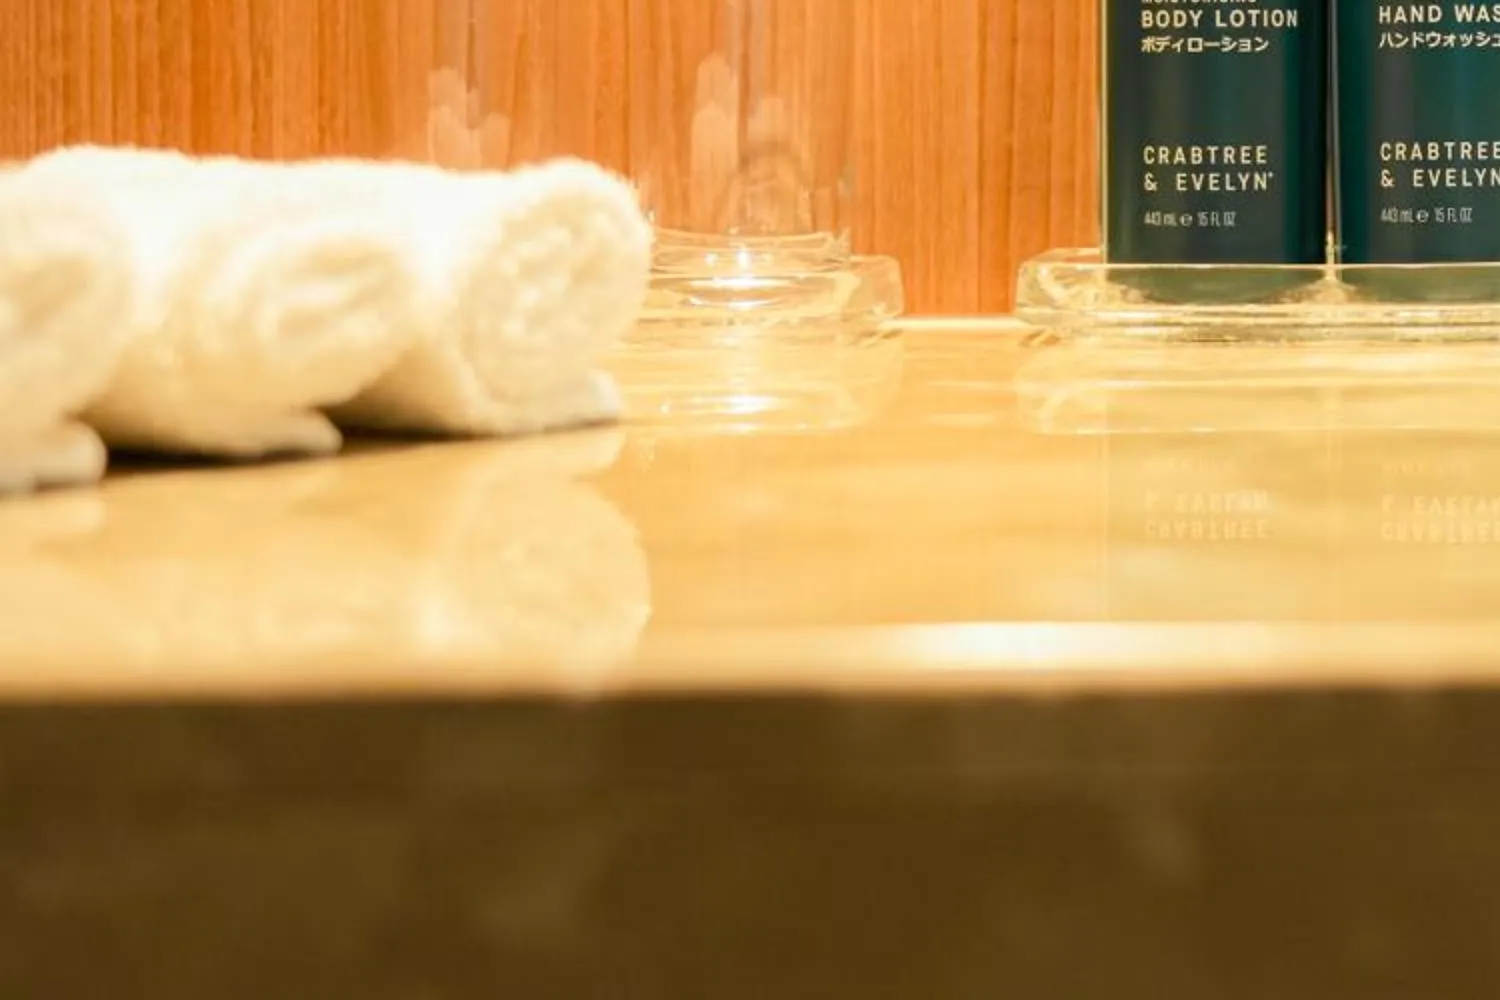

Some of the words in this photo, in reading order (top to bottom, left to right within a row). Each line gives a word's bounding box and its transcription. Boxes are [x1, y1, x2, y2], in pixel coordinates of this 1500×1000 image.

[1141, 9, 1203, 28] BODY
[1215, 9, 1298, 27] LOTION
[1378, 5, 1443, 24] HAND
[1141, 36, 1269, 53] ボディローション
[1143, 145, 1268, 165] CRABTREE
[1144, 172, 1158, 191] &
[1380, 168, 1395, 187] &
